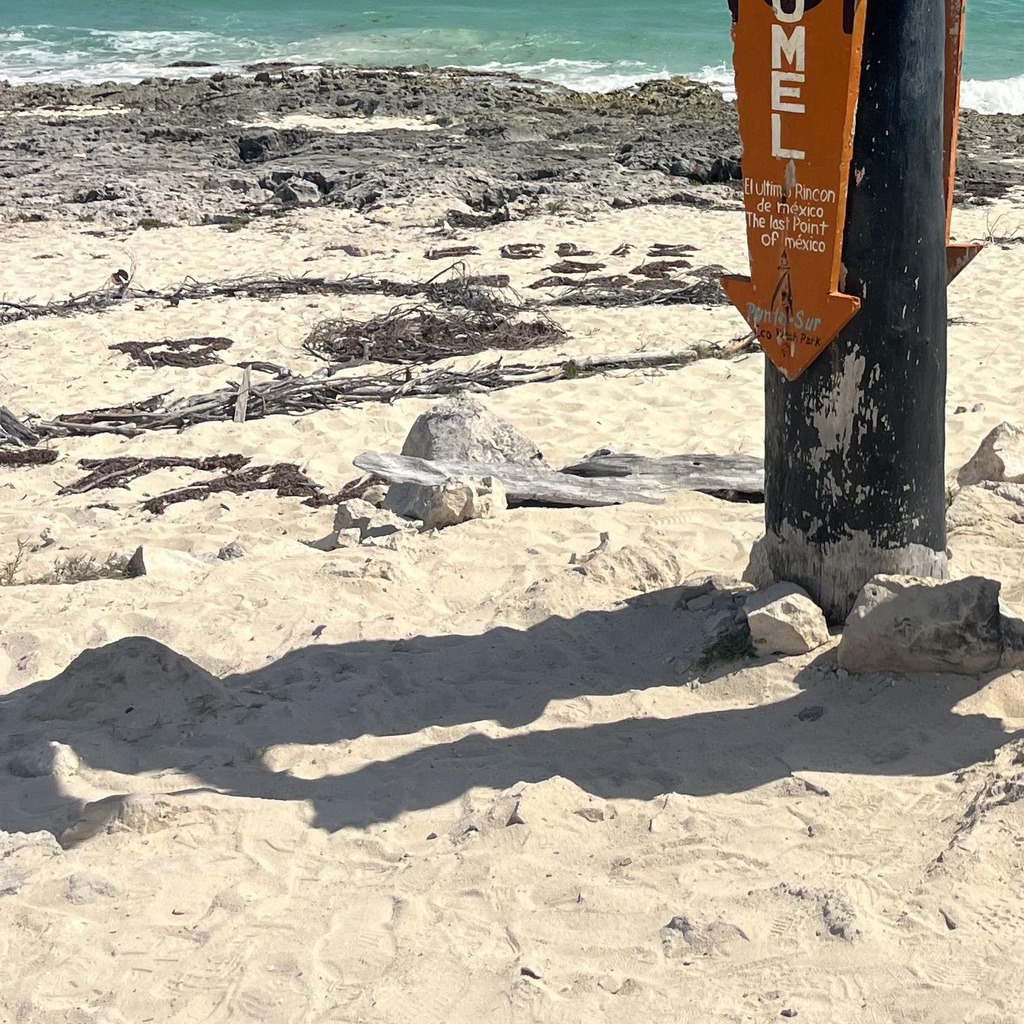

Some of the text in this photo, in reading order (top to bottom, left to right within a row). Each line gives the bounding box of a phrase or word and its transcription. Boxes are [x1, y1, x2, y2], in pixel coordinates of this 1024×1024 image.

[744, 178, 753, 195] El
[795, 183, 836, 204] Rincon
[757, 198, 772, 212] de
[746, 212, 829, 236] The last Point
[784, 234, 826, 253] méxico
